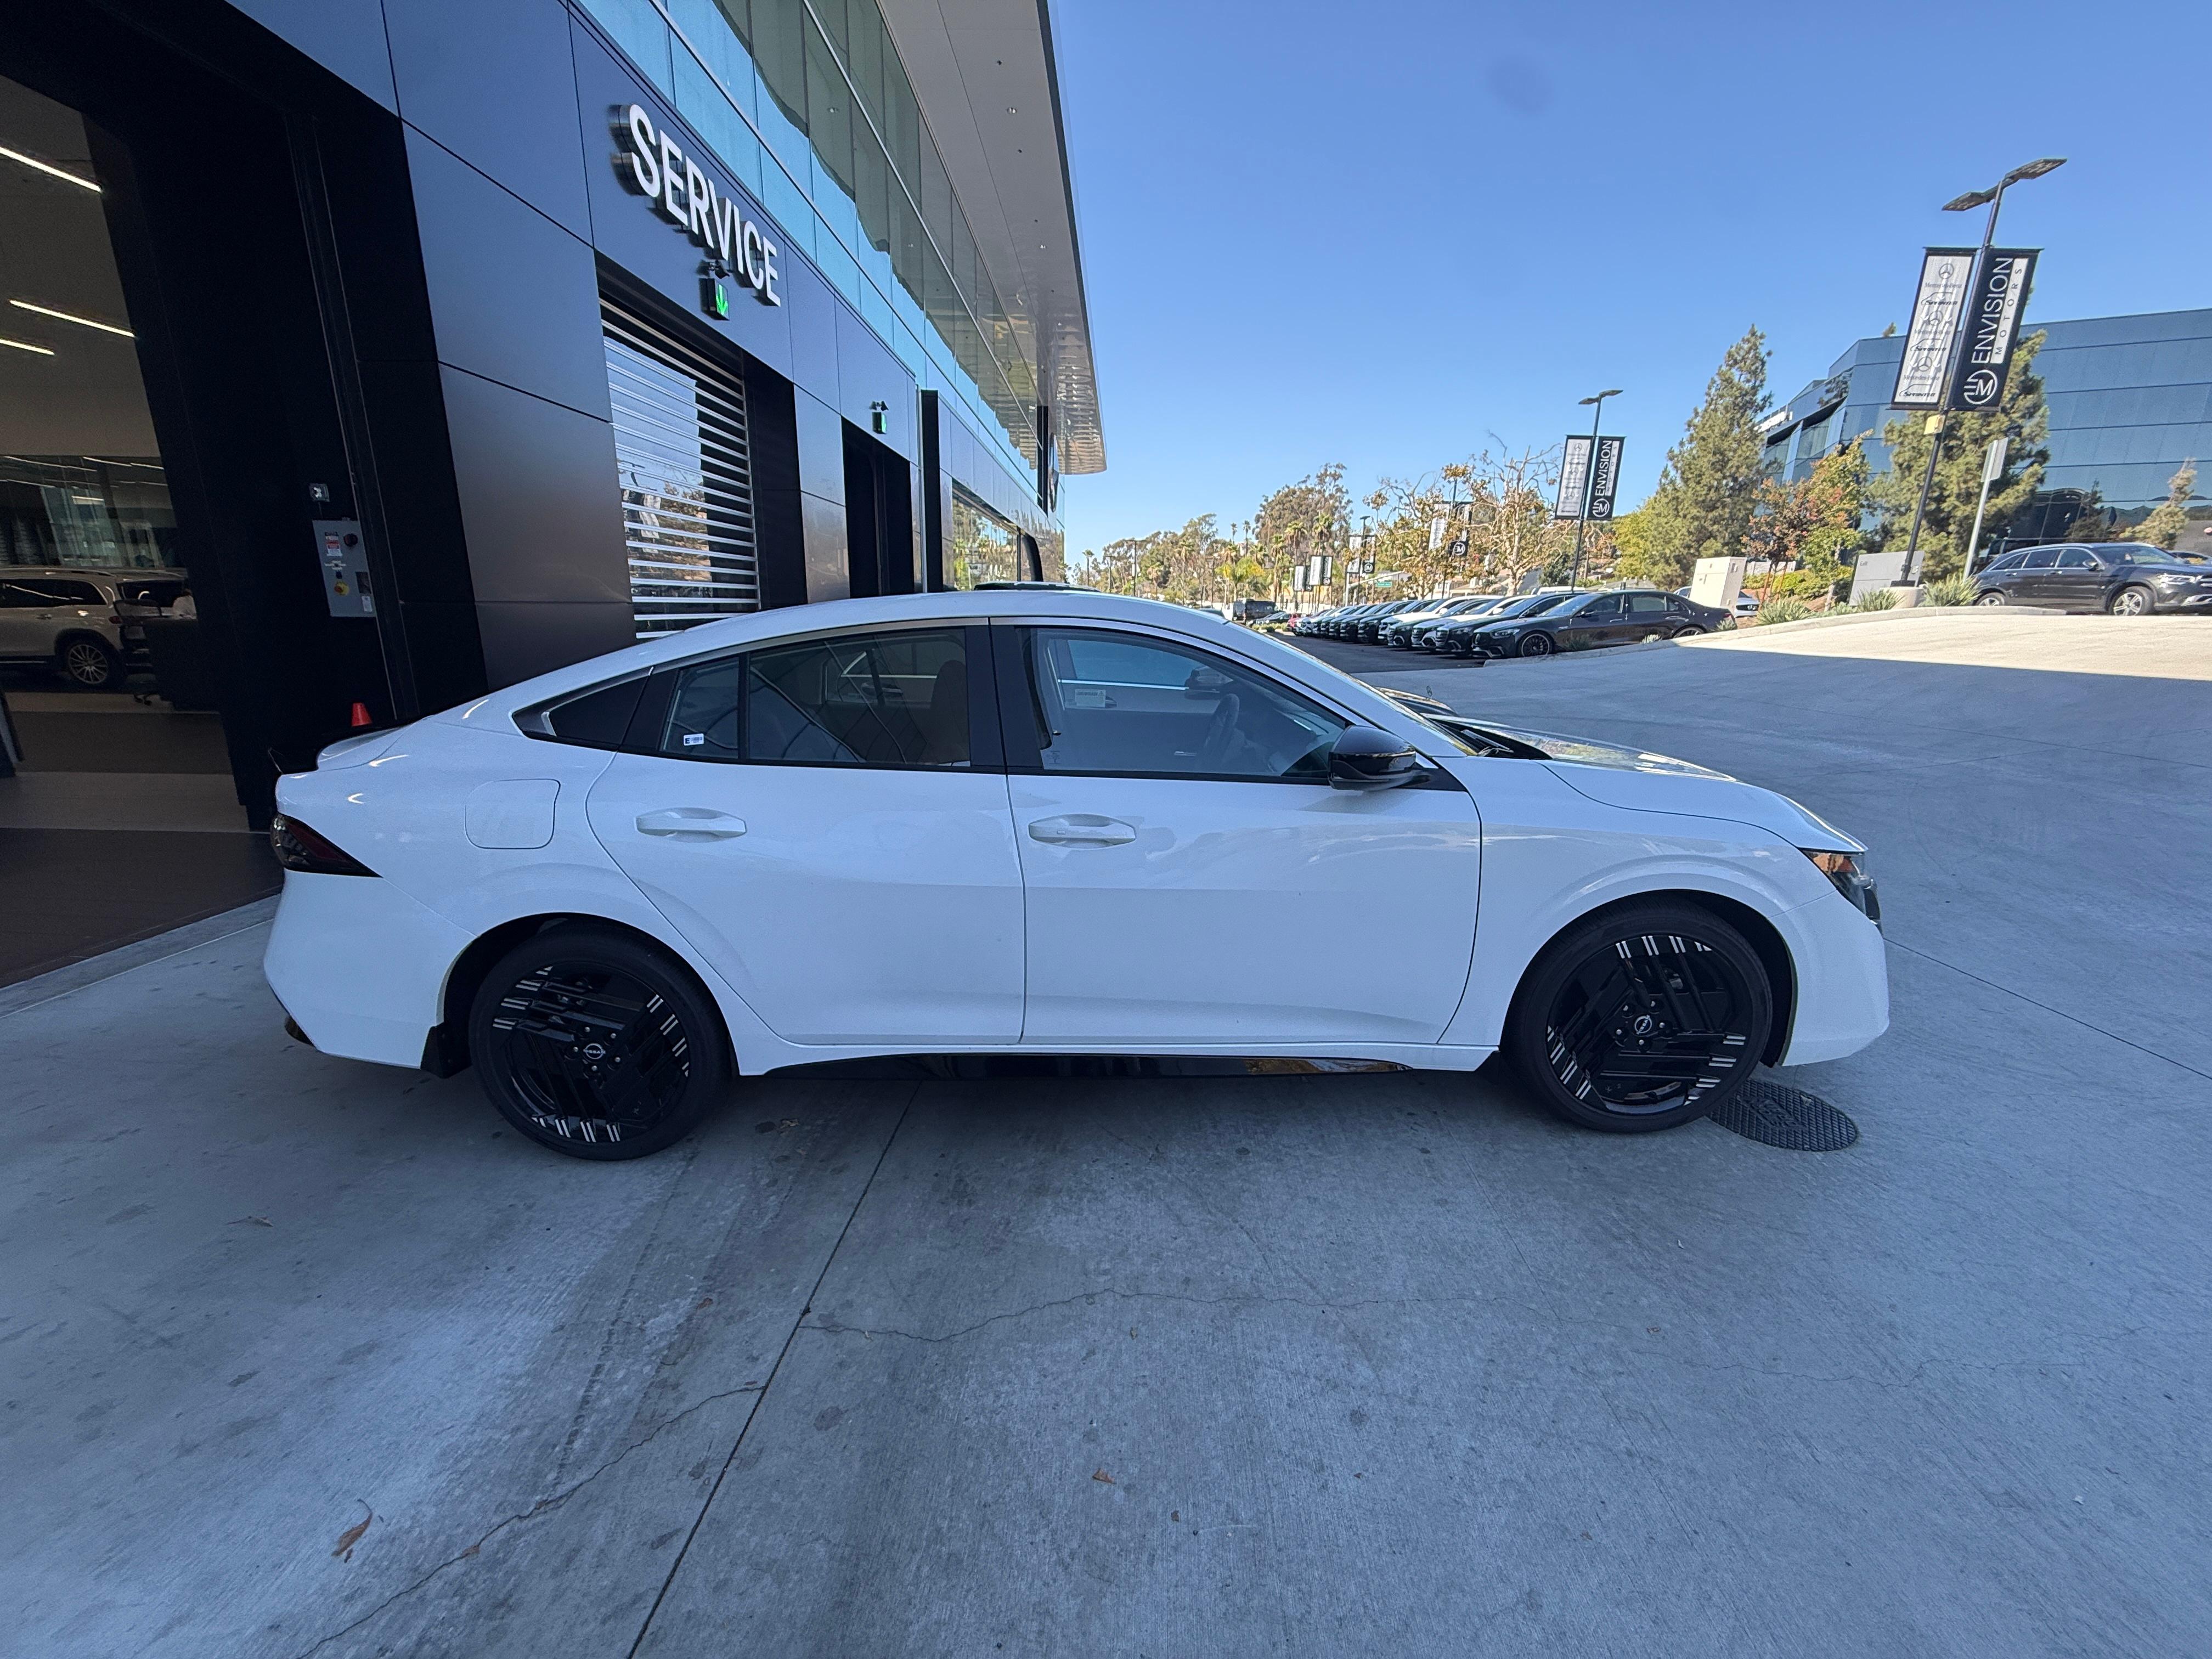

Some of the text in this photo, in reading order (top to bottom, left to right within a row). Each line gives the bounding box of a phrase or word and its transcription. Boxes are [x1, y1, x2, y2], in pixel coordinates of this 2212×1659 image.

[628, 104, 782, 307] SERVICE
[1971, 257, 2015, 364] ENVISION
[1995, 268, 2023, 355] MOTORS
[1595, 440, 1612, 496] ENVISION
